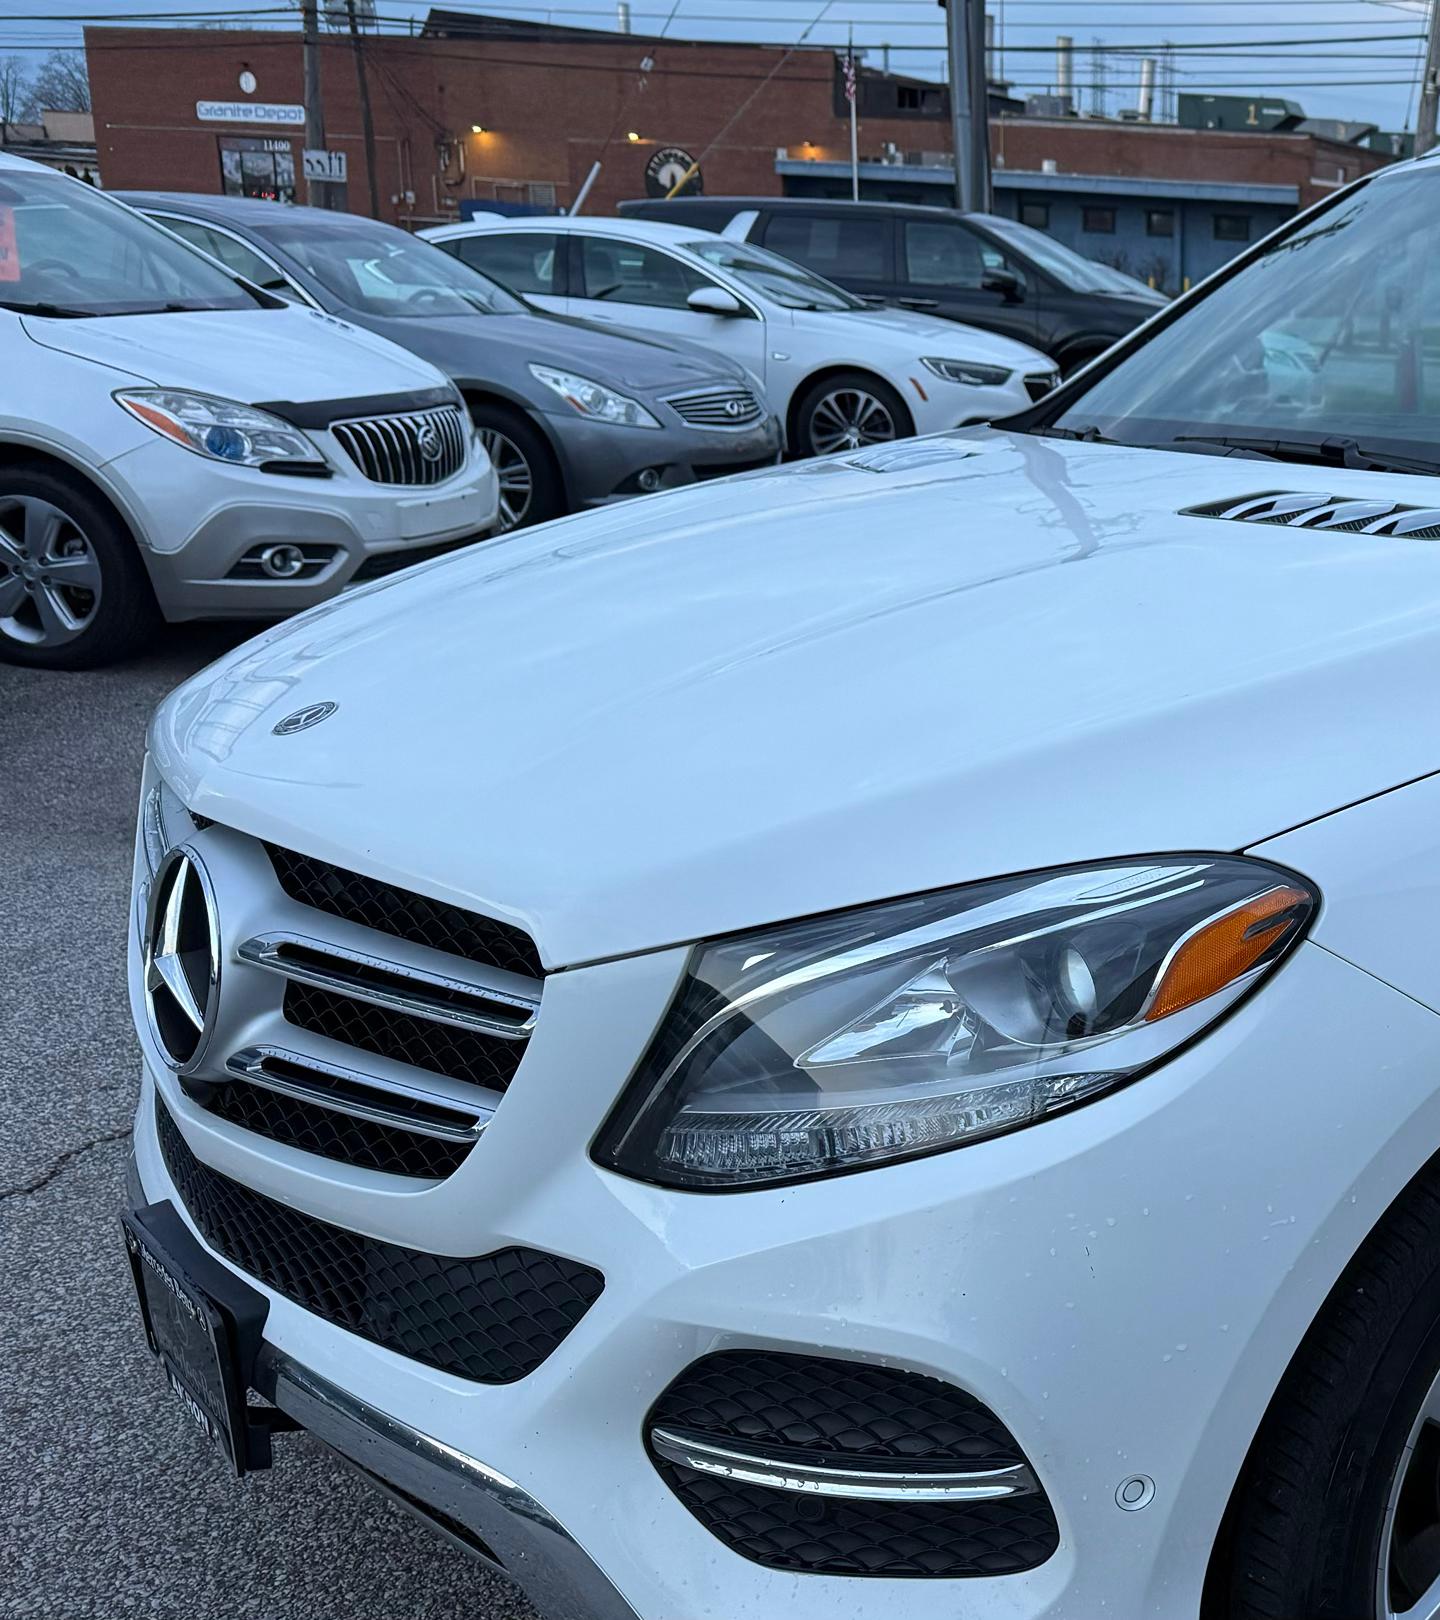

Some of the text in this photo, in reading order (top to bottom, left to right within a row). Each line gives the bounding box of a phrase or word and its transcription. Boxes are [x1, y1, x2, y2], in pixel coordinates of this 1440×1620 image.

[199, 103, 304, 121] Granite Depot
[263, 139, 291, 152] 11400
